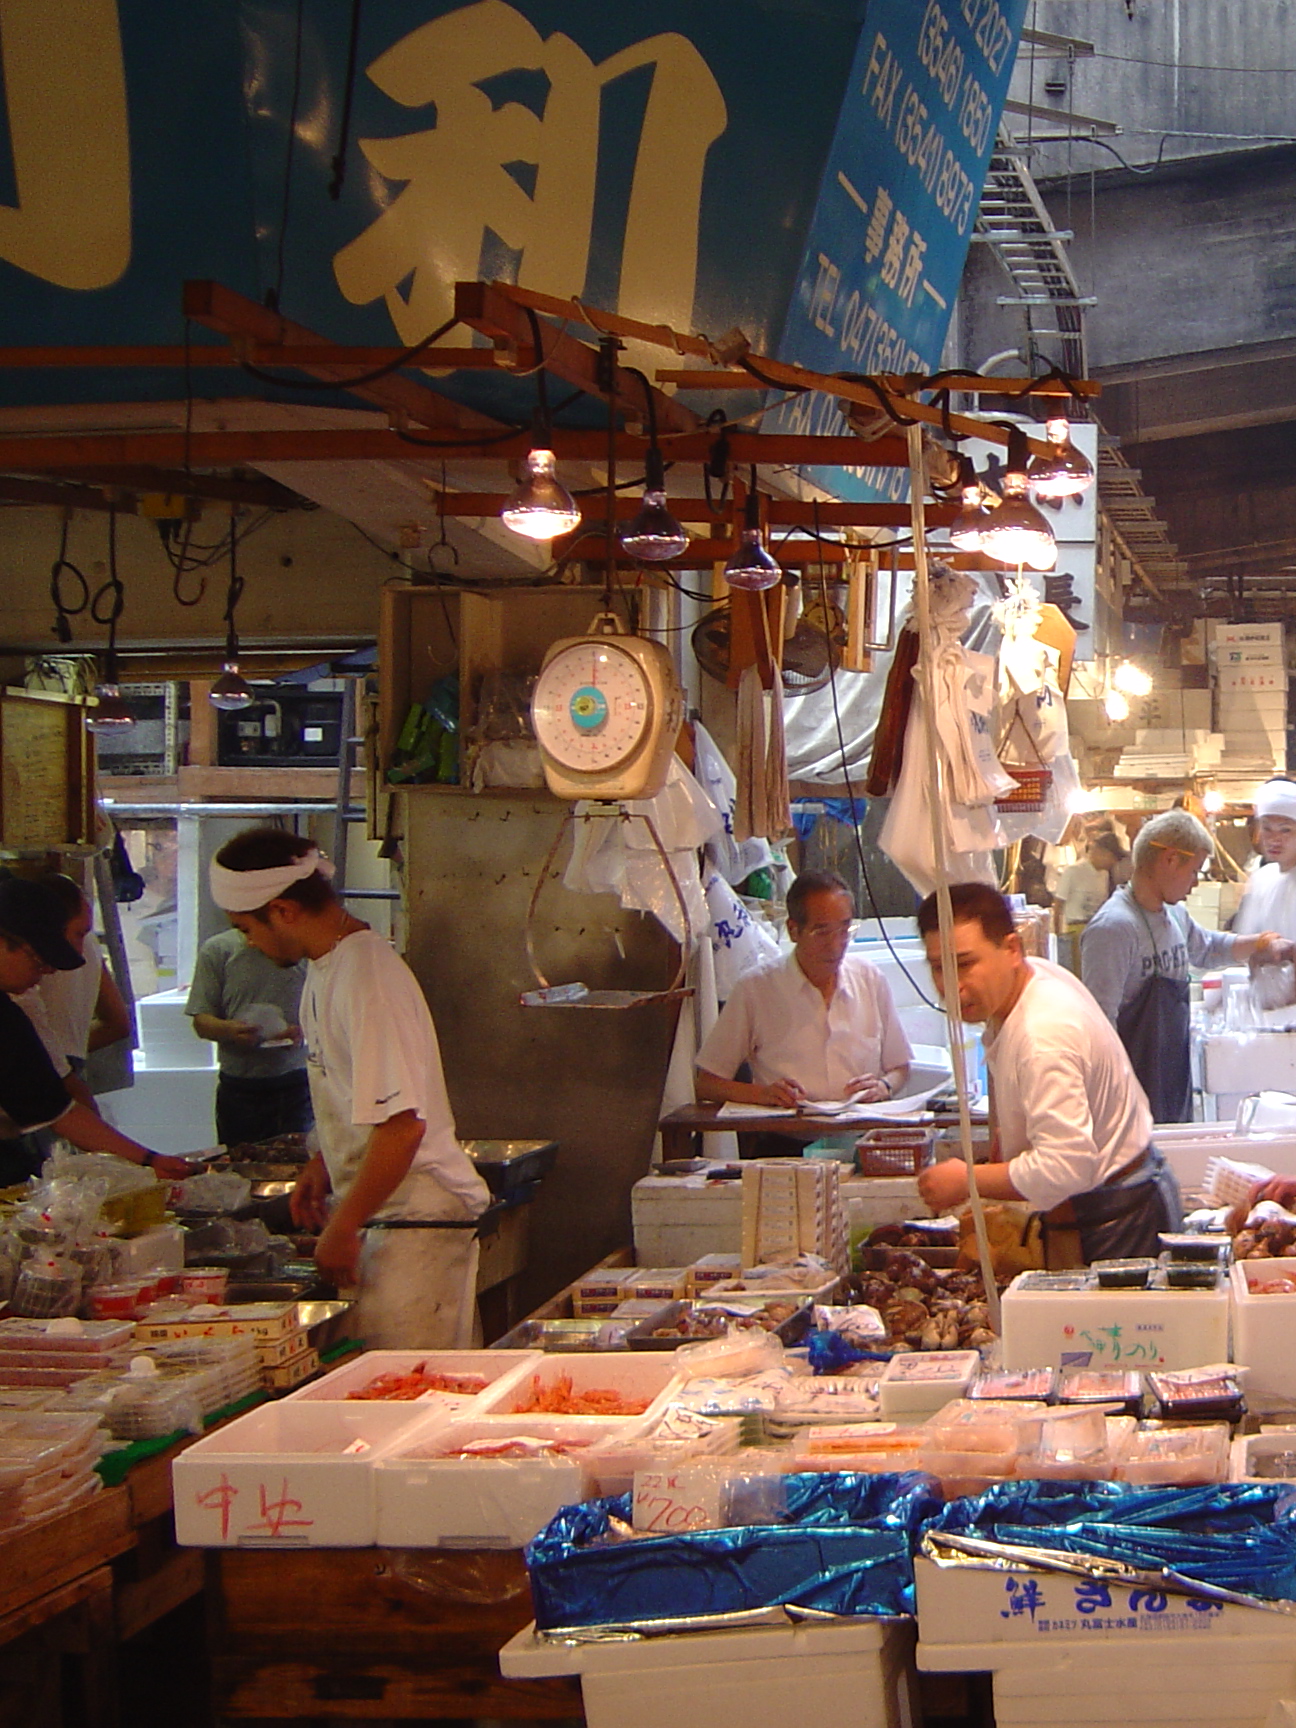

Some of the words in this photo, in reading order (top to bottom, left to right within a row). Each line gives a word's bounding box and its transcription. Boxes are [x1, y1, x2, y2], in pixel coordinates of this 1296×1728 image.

[862, 31, 903, 130] FAX
[809, 252, 841, 338] TEL
[864, 185, 928, 309] 事務所
